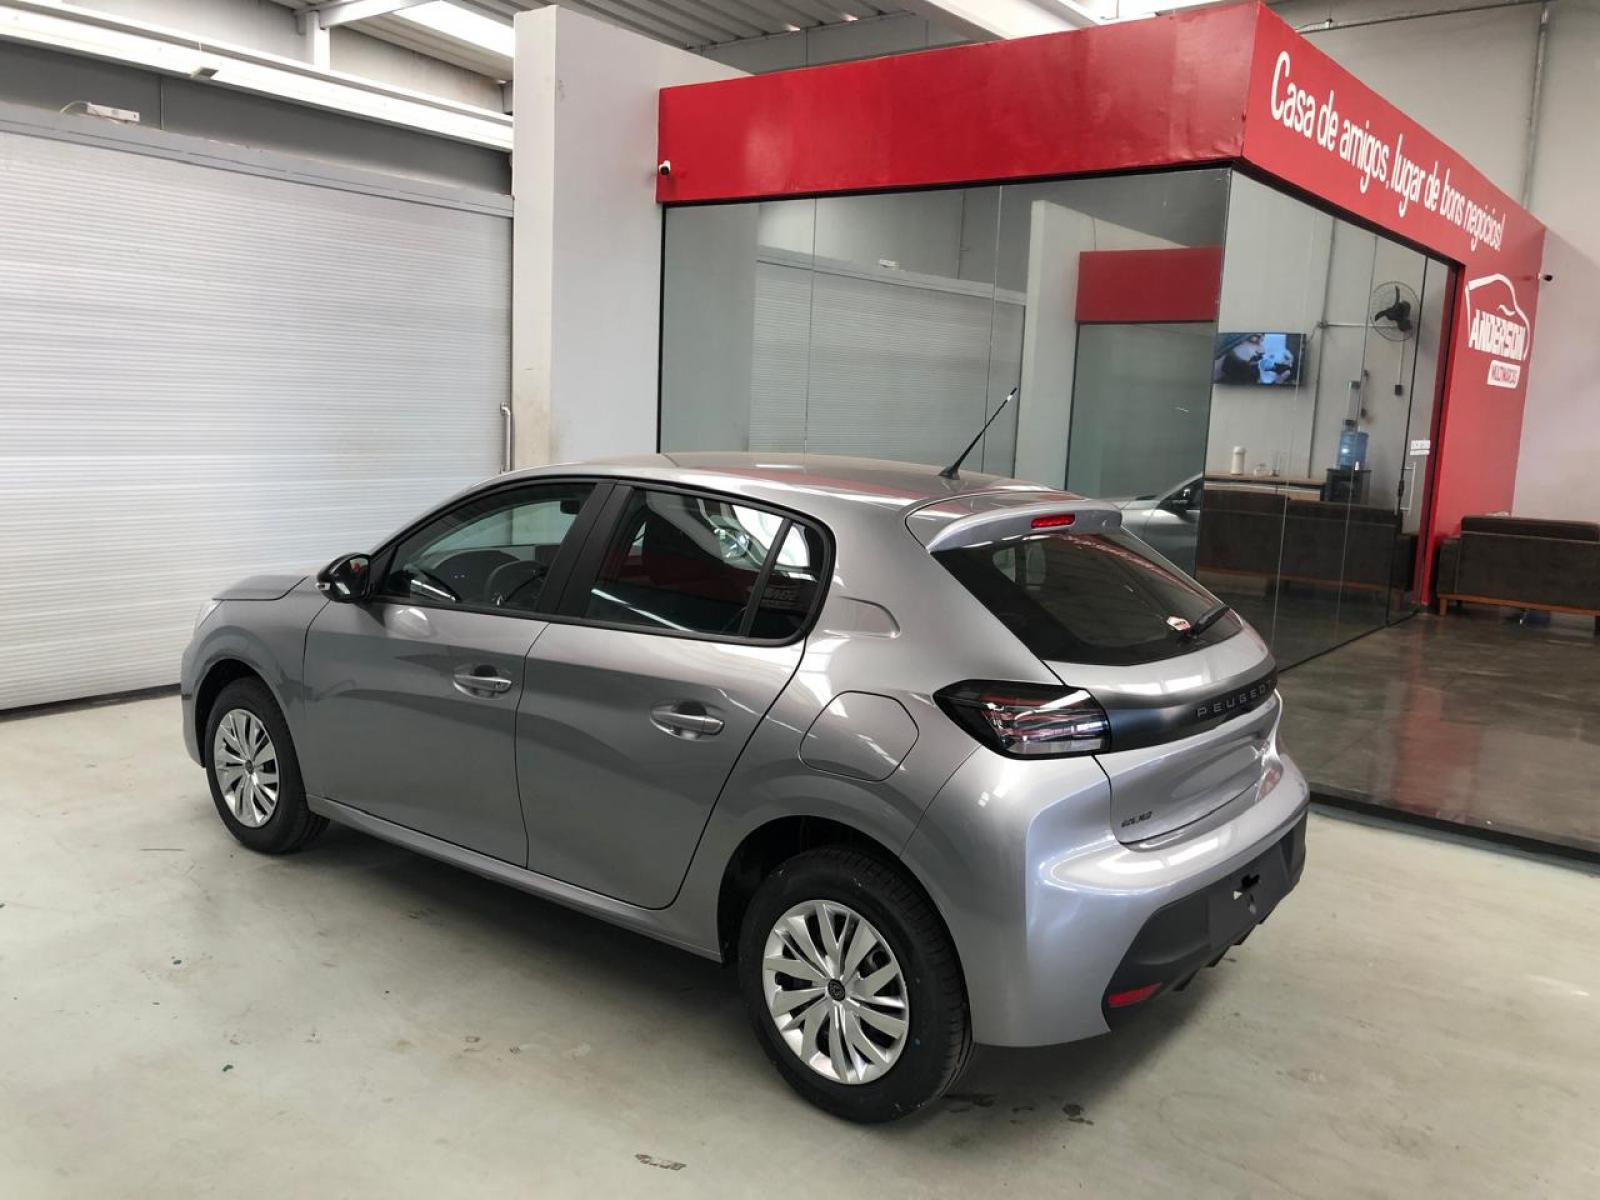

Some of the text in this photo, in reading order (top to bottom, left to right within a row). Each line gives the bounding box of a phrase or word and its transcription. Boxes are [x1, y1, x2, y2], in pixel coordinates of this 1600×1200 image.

[1270, 51, 1316, 138] Casa
[1317, 90, 1338, 152] de
[1340, 119, 1390, 194] amigos,
[1391, 133, 1426, 218] lugar
[1424, 160, 1441, 212] de
[1440, 168, 1465, 227] bons
[1468, 309, 1526, 361] ANDERSON
[1197, 680, 1272, 718] PEUGEOT
